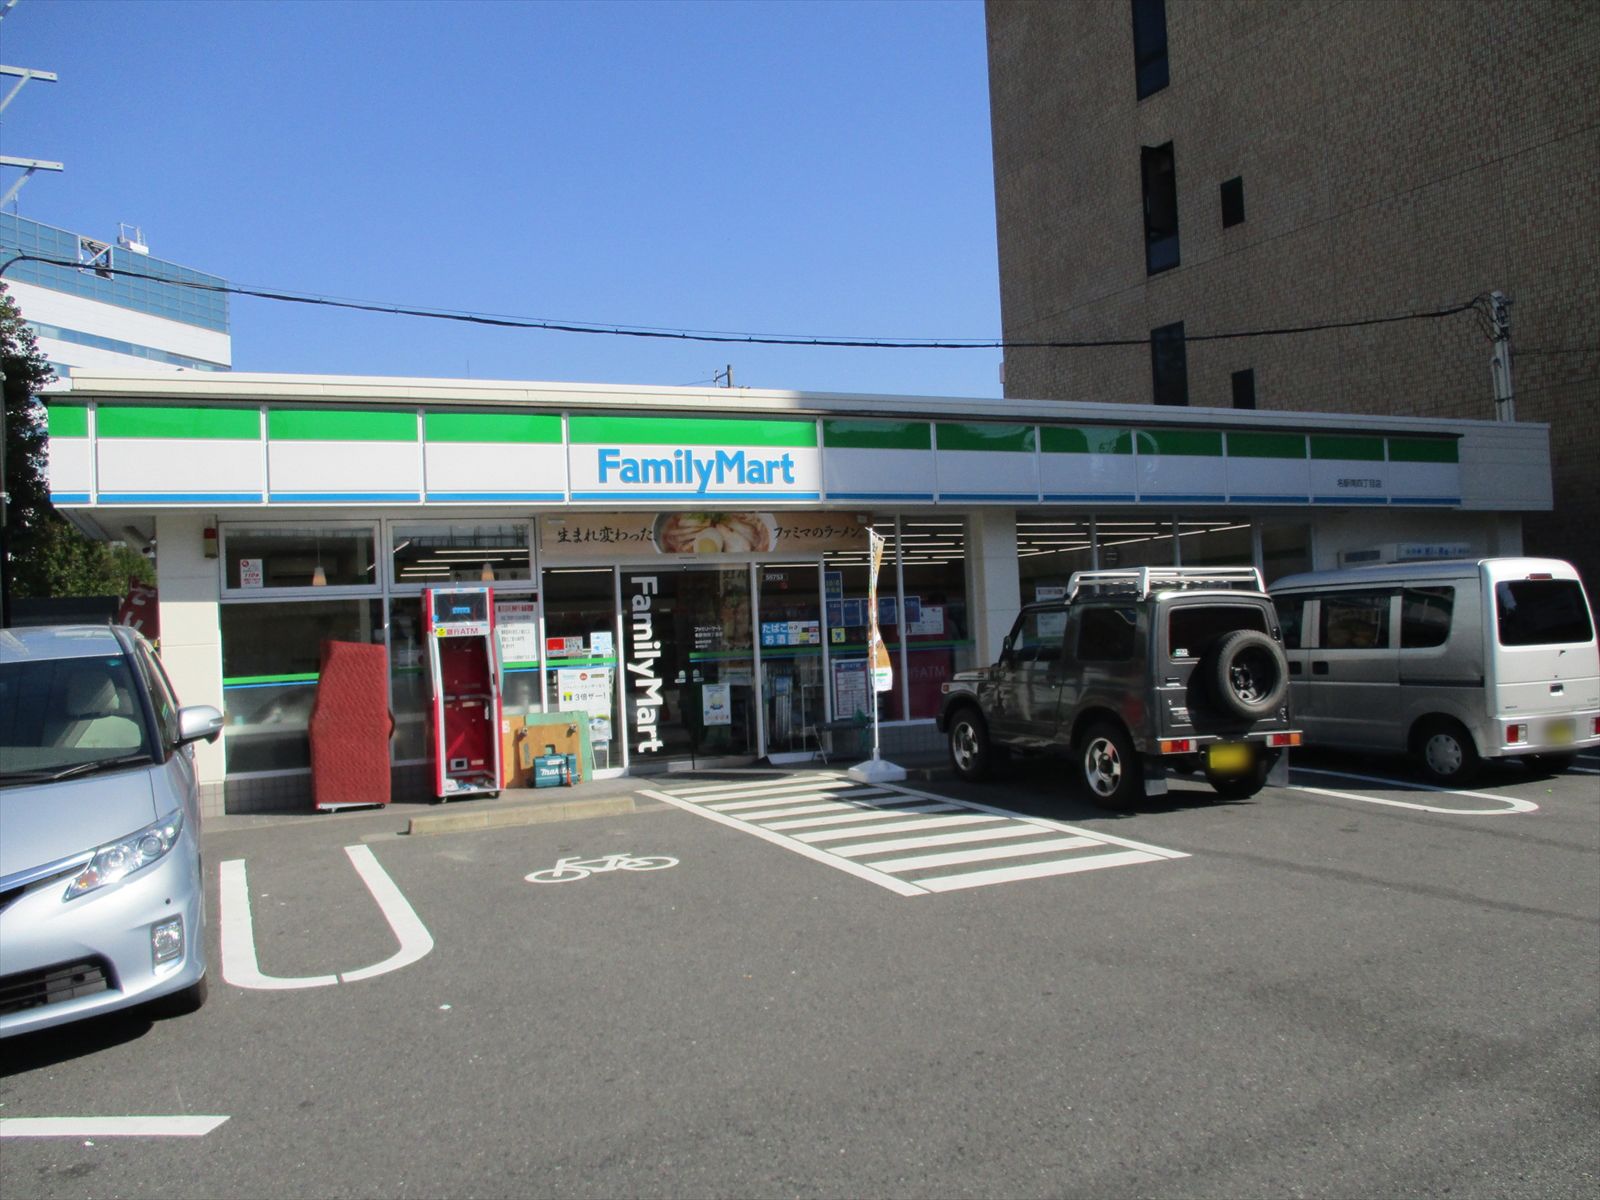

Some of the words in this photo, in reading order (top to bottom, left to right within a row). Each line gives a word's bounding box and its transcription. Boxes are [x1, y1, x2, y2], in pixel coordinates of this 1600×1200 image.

[598, 448, 795, 493] FamilyMart
[762, 623, 788, 633] たばこ
[627, 576, 663, 753] FamilyMart
